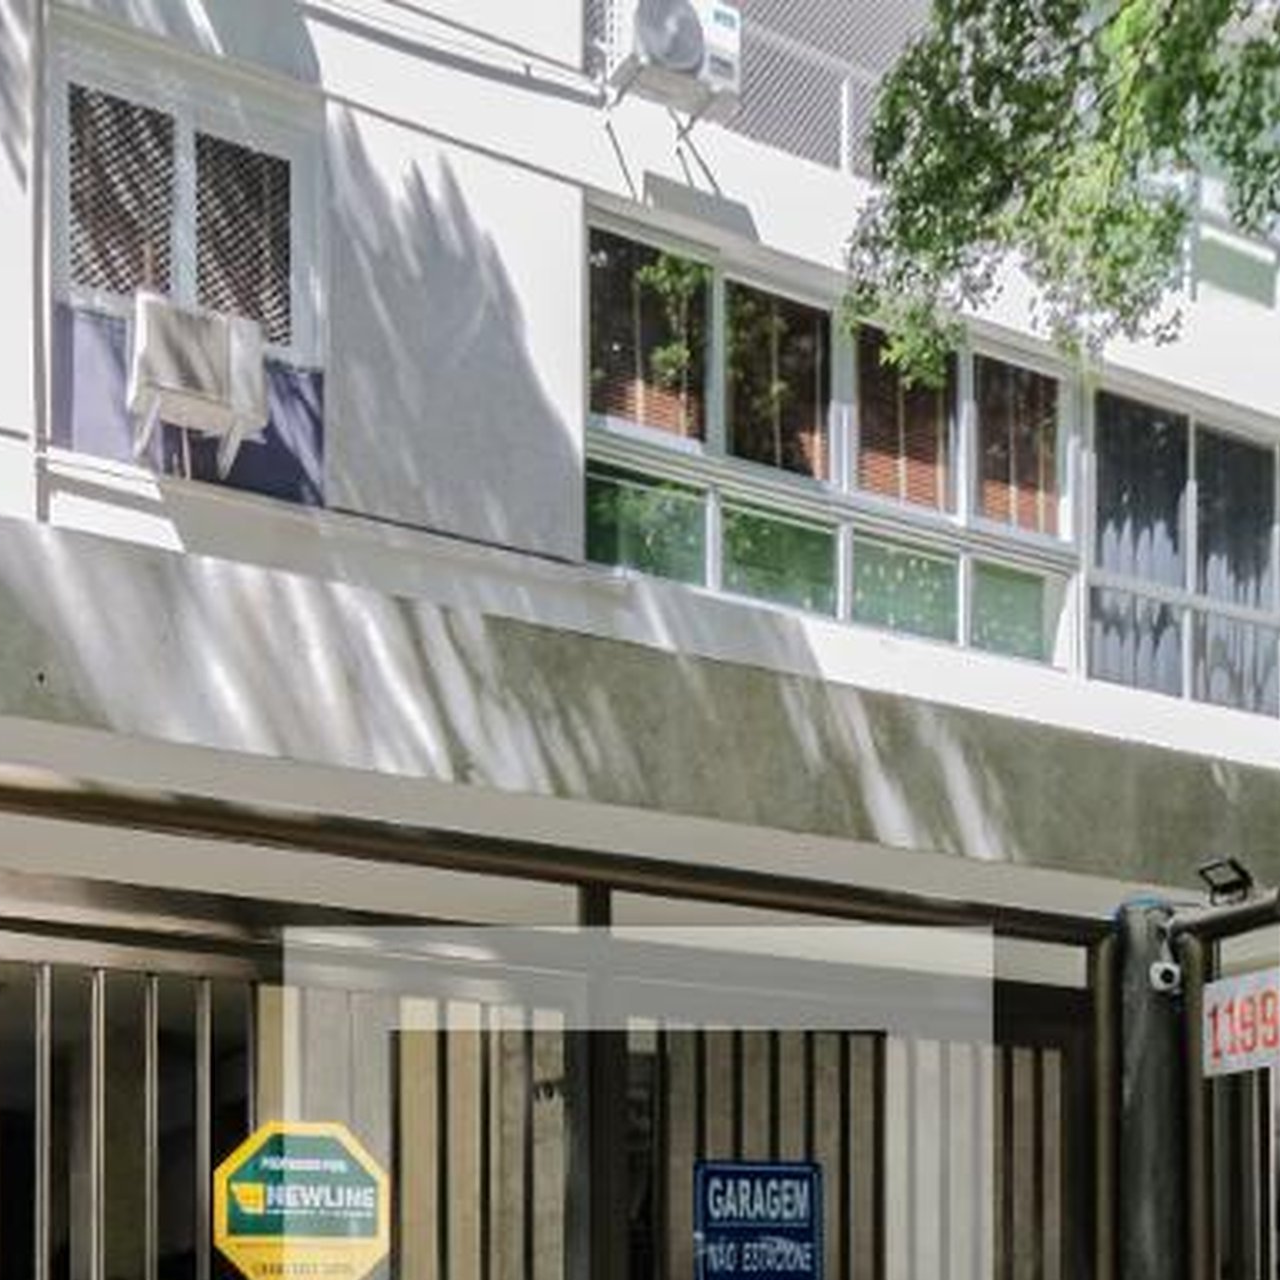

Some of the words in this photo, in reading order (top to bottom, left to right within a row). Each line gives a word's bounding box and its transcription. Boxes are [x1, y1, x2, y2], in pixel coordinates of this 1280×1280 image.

[1208, 990, 1279, 1063] 1199
[267, 1184, 375, 1208] NEWLINE
[709, 1178, 809, 1220] GARAGEM
